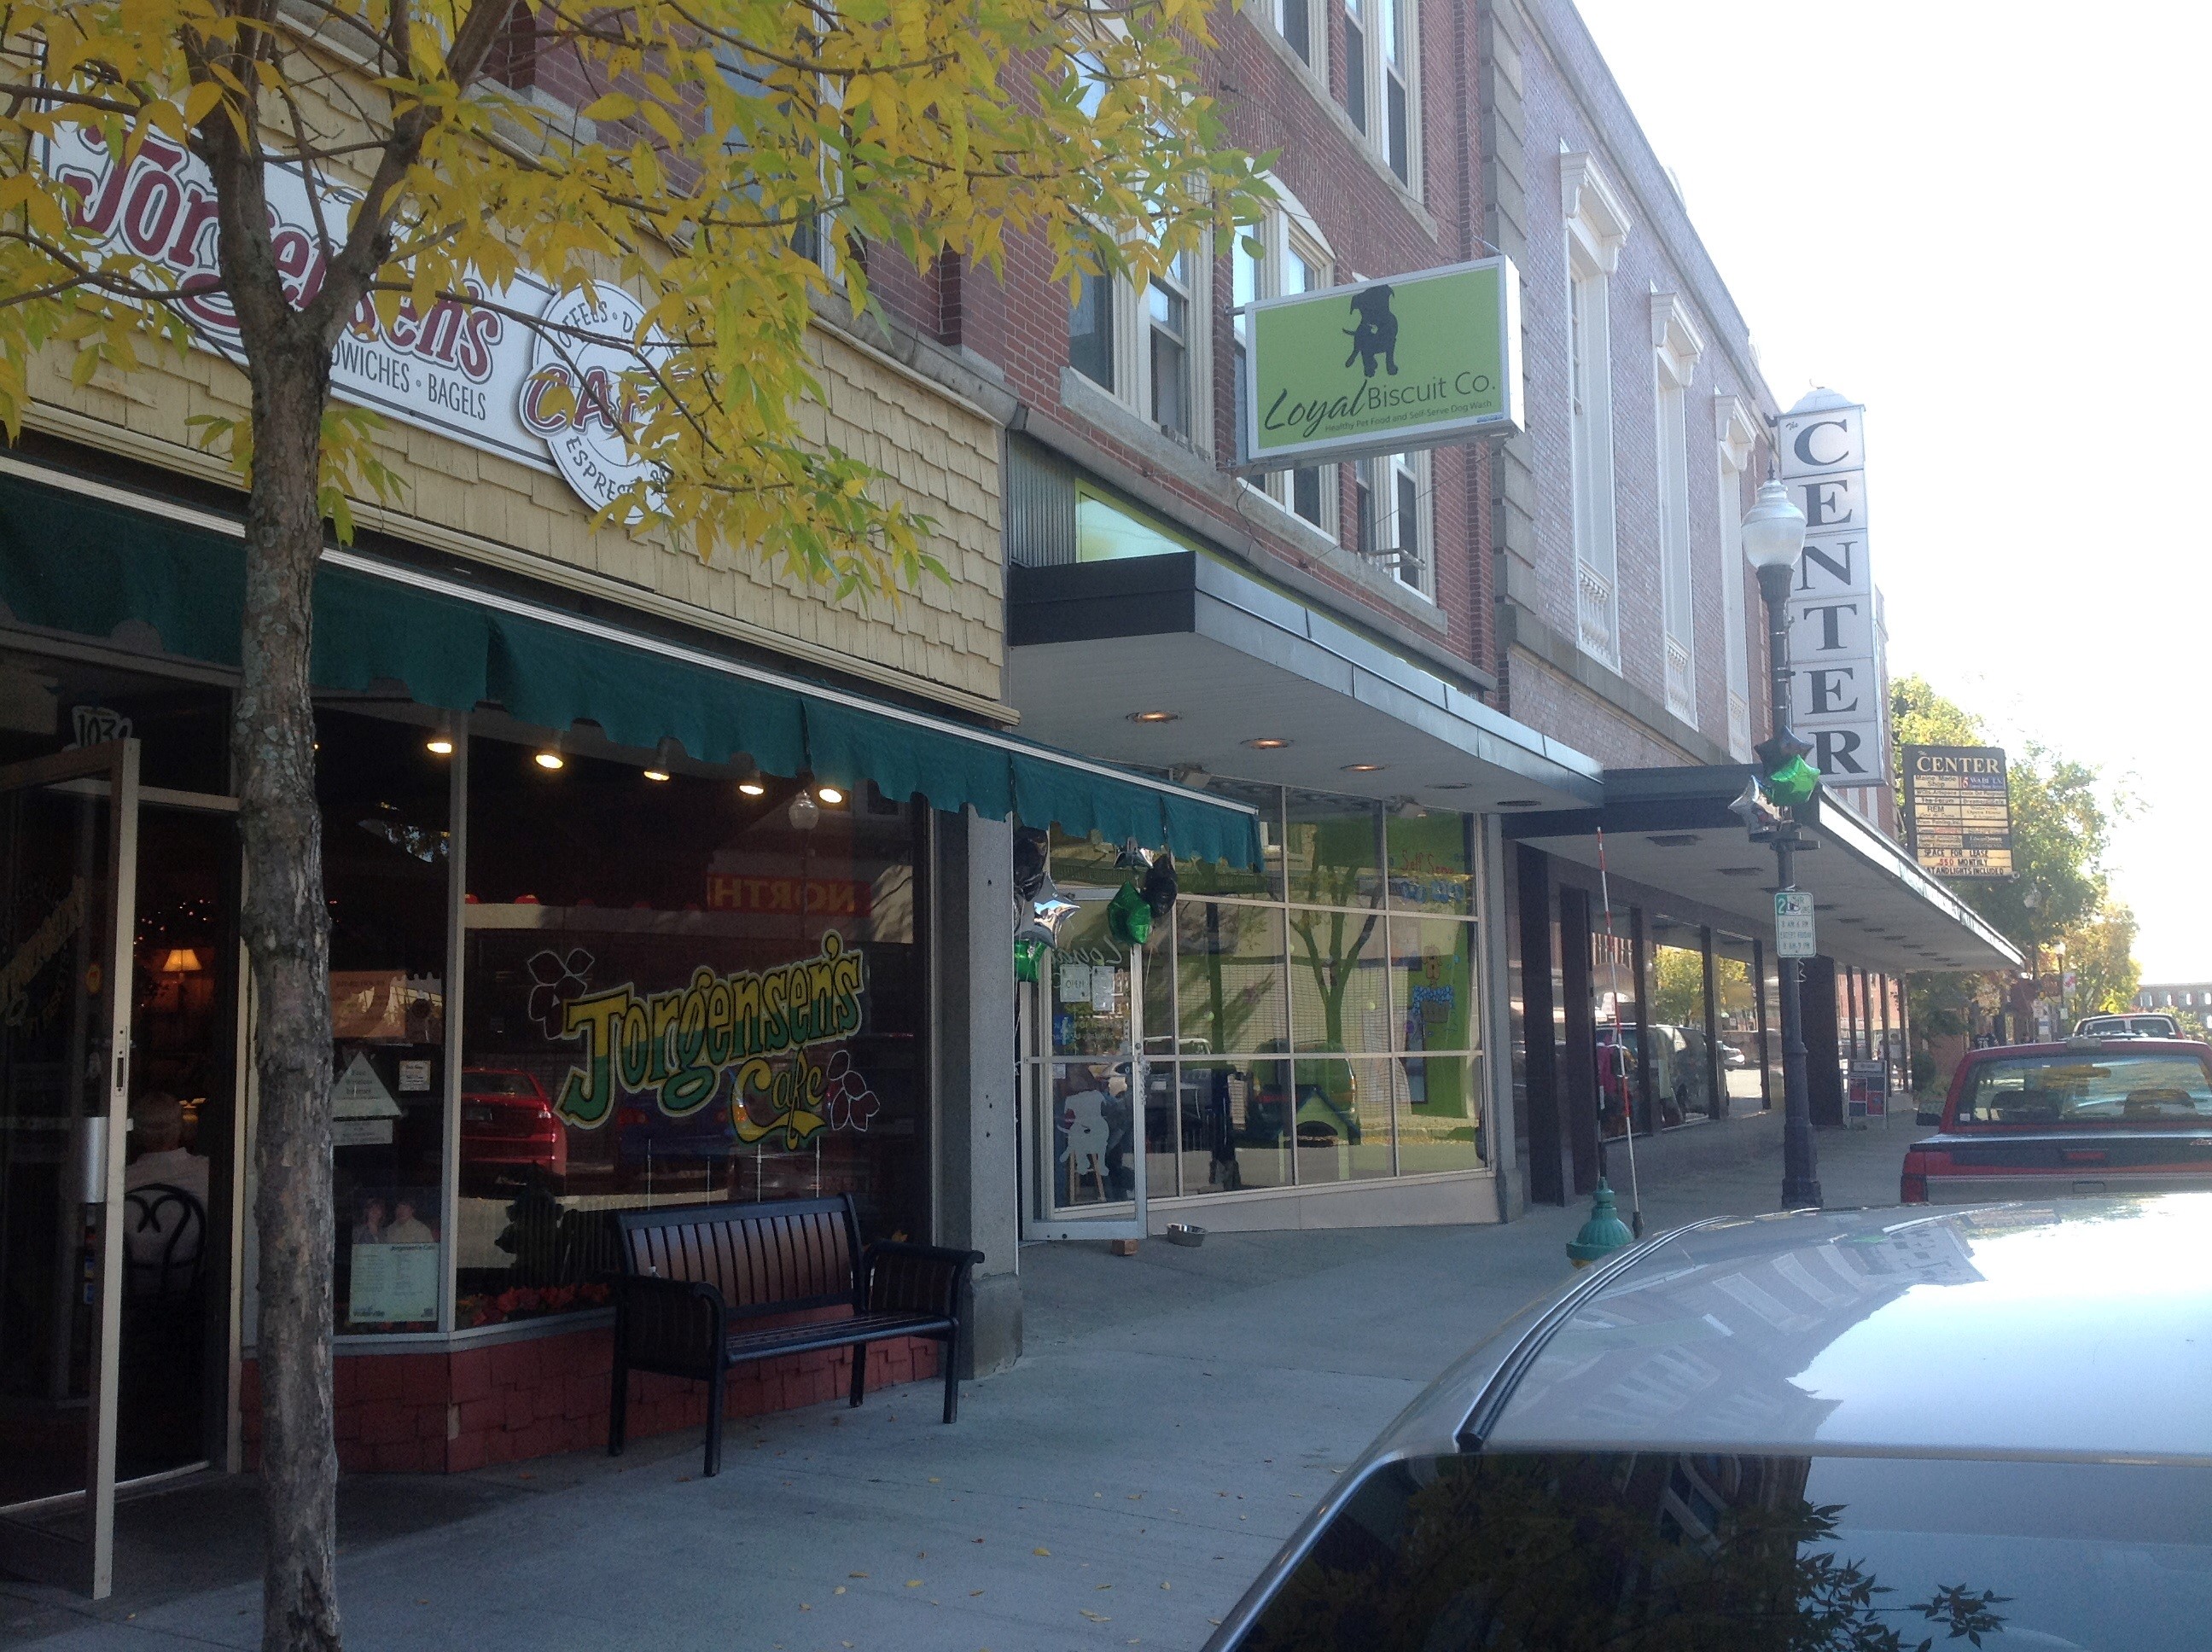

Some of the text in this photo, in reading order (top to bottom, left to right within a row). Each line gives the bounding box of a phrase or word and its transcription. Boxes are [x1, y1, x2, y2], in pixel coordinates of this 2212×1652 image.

[428, 373, 486, 421] BAGELS
[1264, 371, 1496, 438] Loyal Biscuit Co.
[1324, 399, 1493, 433] Healthy Pet Food and Self-Serve Dog Wash
[1794, 418, 1869, 776] CENTER
[1917, 756, 2000, 773] CENTER
[1778, 898, 1786, 914] 2
[555, 930, 864, 1130] Jorgensen's
[731, 1049, 828, 1151] Cafe
